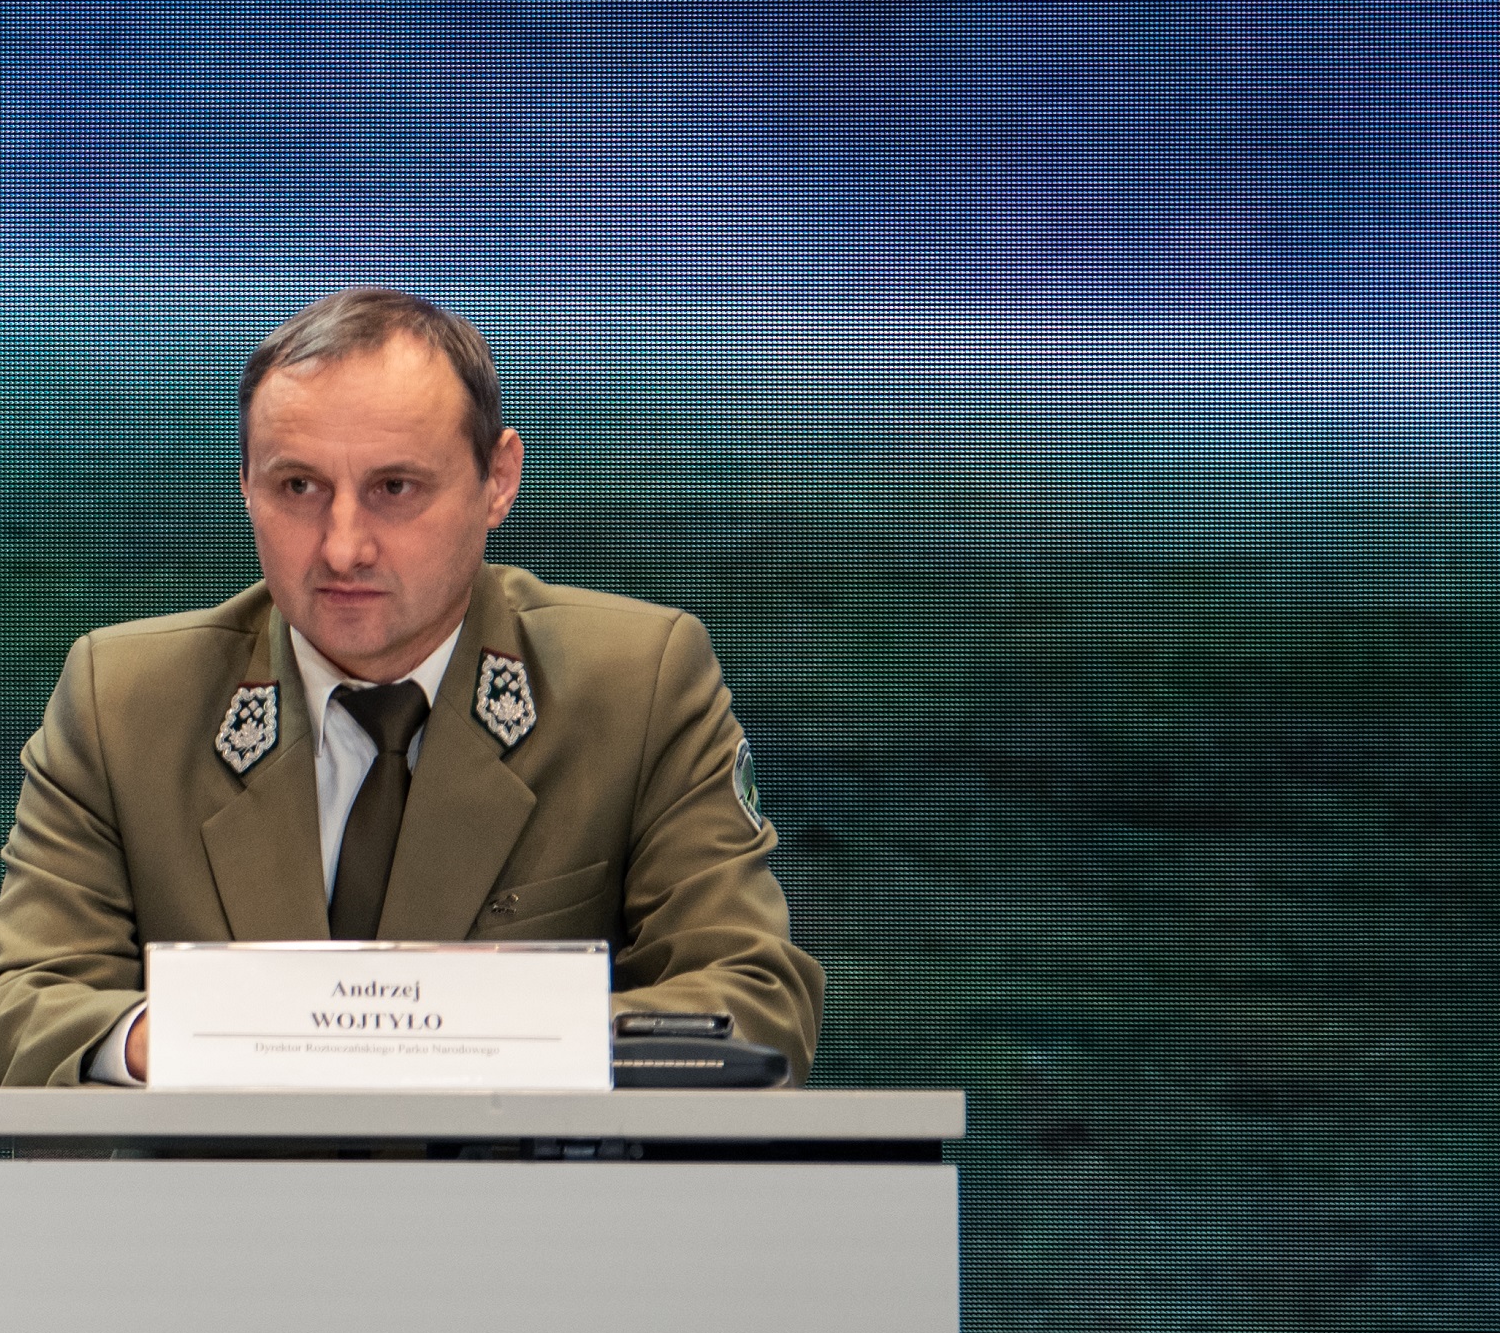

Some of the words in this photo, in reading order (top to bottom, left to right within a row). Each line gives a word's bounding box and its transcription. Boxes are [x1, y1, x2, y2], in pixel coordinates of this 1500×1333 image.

[332, 980, 421, 1003] Andrzej
[254, 1042, 302, 1055] Dyrektor
[305, 1043, 395, 1056] Roztoczańskiego
[398, 1043, 429, 1054] Parku
[432, 1044, 500, 1057] Narodowego
